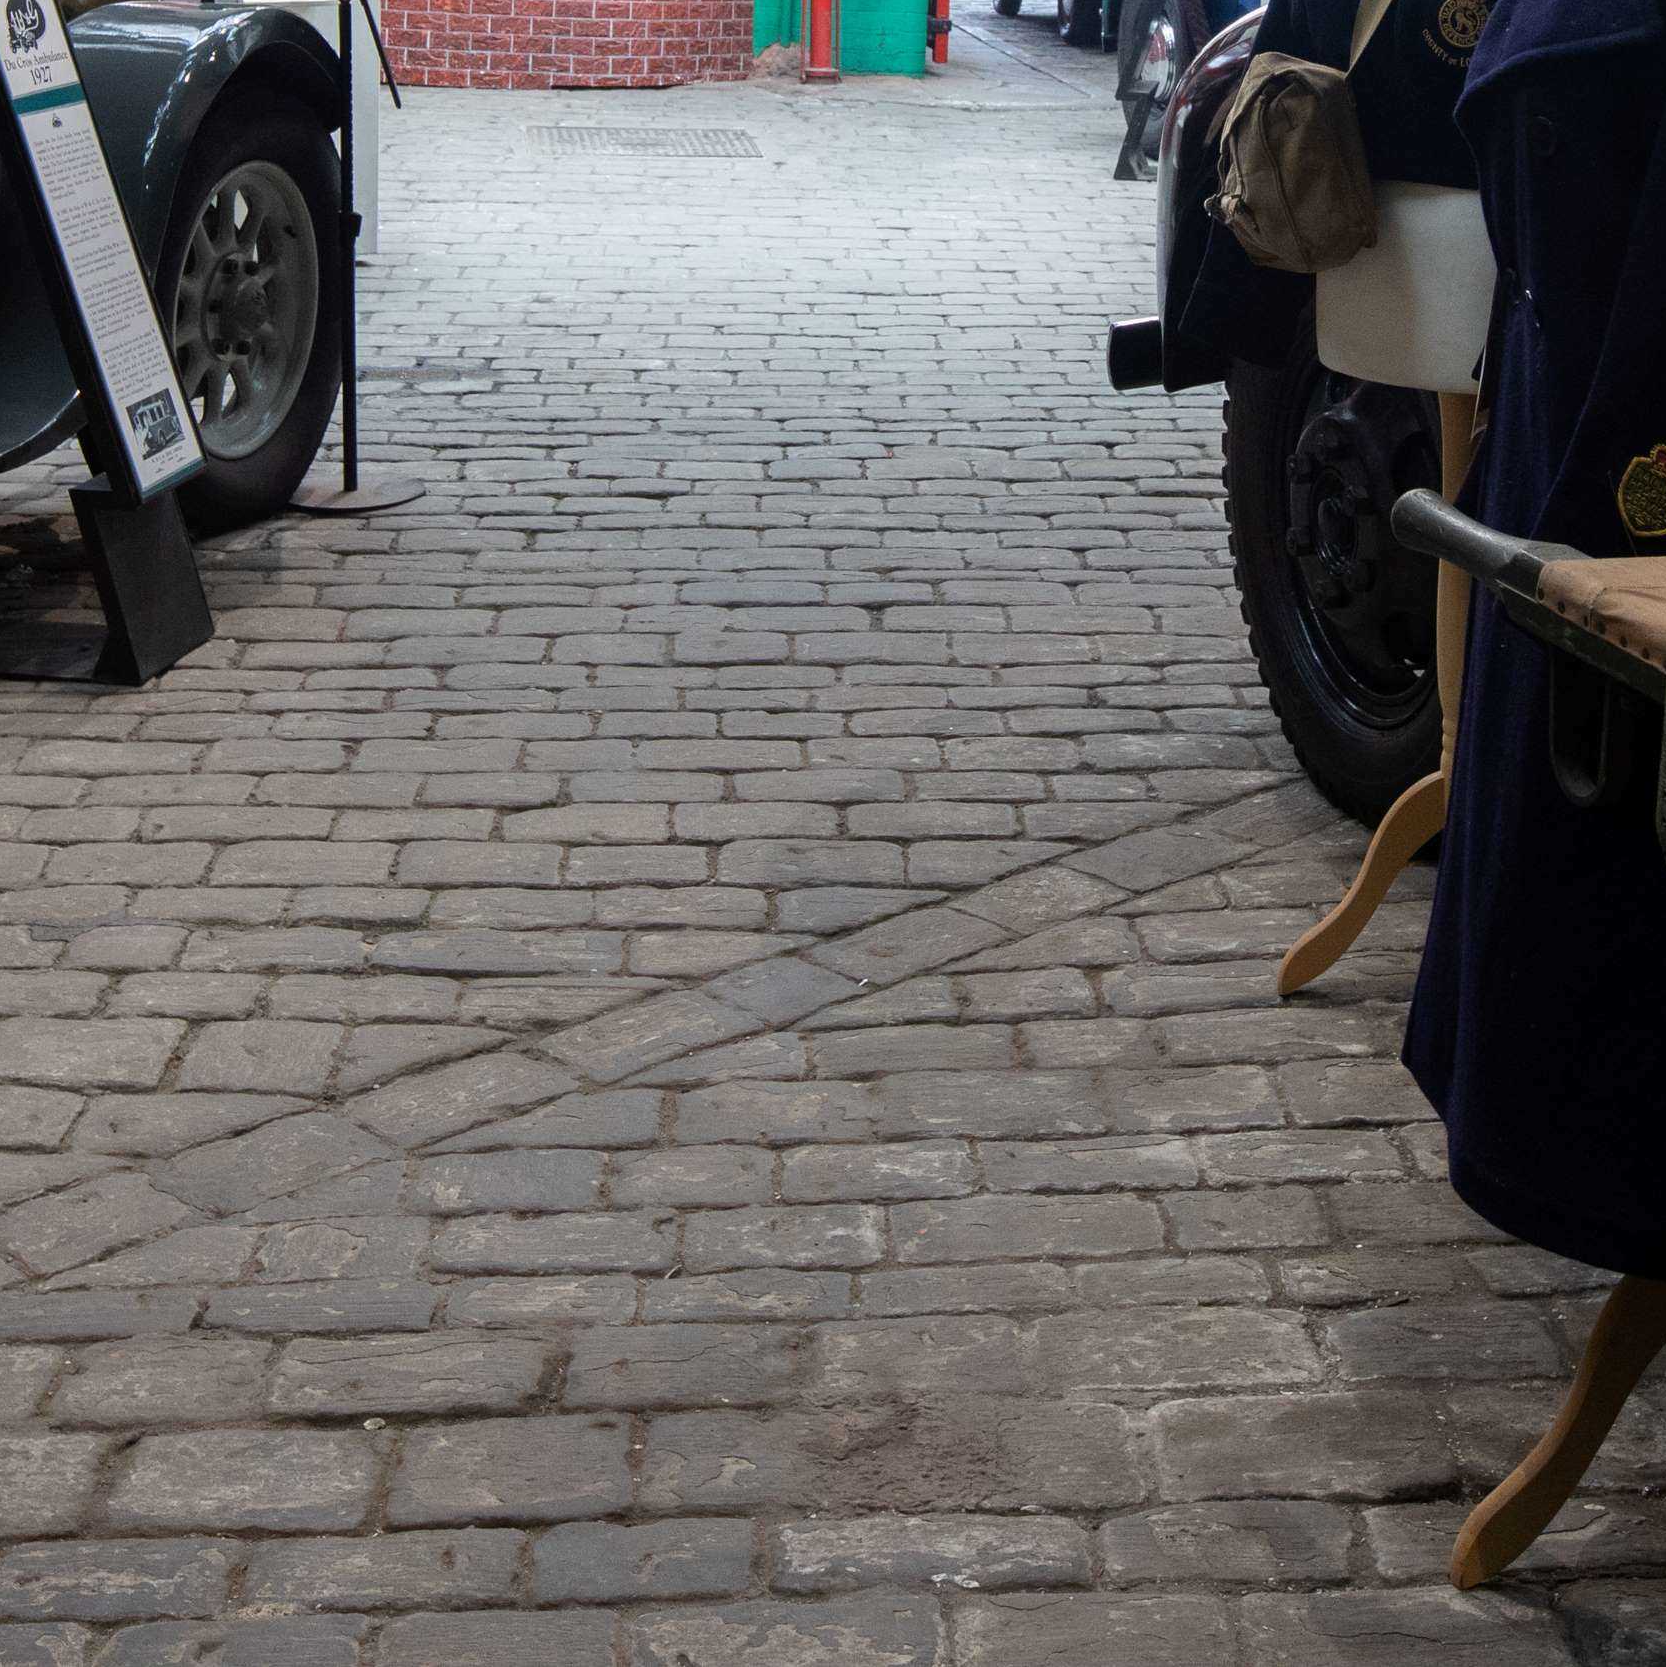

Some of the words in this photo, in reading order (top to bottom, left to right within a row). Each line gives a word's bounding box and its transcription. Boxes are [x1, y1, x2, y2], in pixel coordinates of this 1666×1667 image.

[4, 59, 16, 72] Du
[33, 50, 69, 67] Ambulance
[30, 66, 53, 85] 1927
